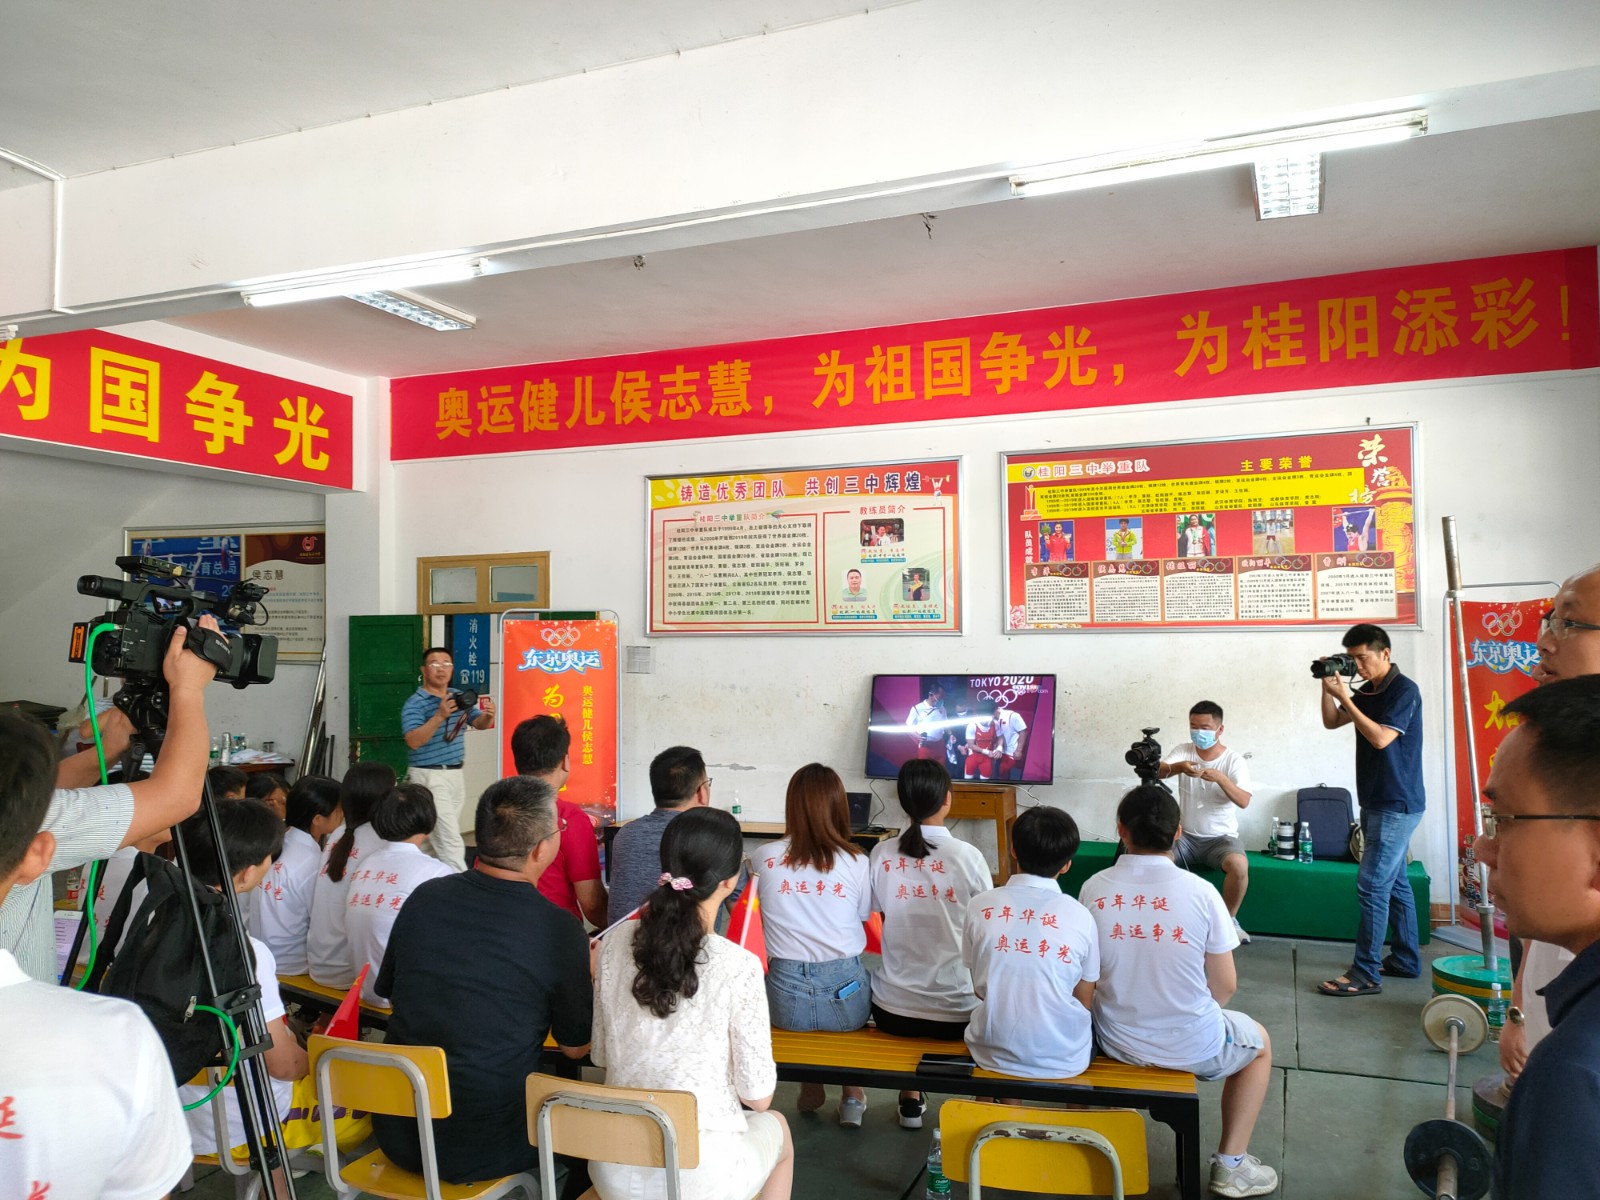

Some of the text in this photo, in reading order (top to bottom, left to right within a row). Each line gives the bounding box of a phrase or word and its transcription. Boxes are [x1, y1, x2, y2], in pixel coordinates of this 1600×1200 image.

[0, 338, 331, 471] 为国争光
[1037, 459, 1150, 478] 桂阳三中举重队
[1241, 456, 1312, 472] 主要荣誉
[680, 472, 921, 502] 铸造优秀团队 共创三中辉煌
[700, 513, 765, 522] 桂阳三中举重队简介
[860, 505, 906, 515] 教练员简介
[252, 569, 284, 581] 侯志慧
[468, 618, 478, 667] 消火栓
[519, 649, 601, 672] 东京奥运
[471, 671, 485, 684] 119
[970, 676, 1035, 688] TOKYO 2020
[582, 685, 593, 765] 奥运健儿侯志慧
[882, 856, 946, 873] 百年华诞
[778, 879, 846, 898] 奥运争光
[895, 883, 958, 903] 奥运争光
[1095, 894, 1170, 912] 百年华诞
[981, 907, 1059, 929] 百年华诞
[1109, 922, 1188, 944] 奥运争光
[994, 933, 1072, 964] 奥运争光
